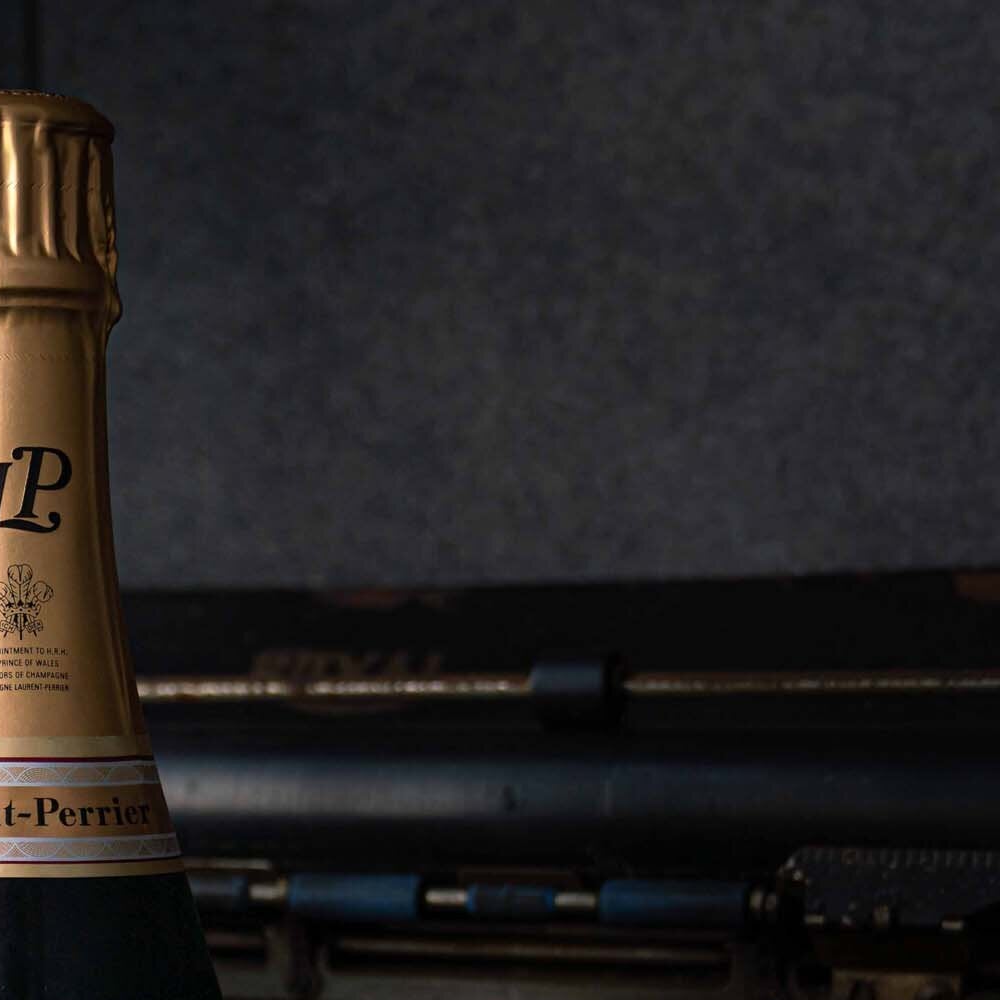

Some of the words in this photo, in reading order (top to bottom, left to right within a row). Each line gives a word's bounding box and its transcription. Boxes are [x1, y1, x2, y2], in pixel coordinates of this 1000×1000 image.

[36, 647, 44, 655] TO
[35, 659, 59, 667] WALES
[15, 671, 23, 679] OF
[26, 671, 69, 680] CHAMPAGNE
[14, 683, 69, 692] LAURENT-PERRIER
